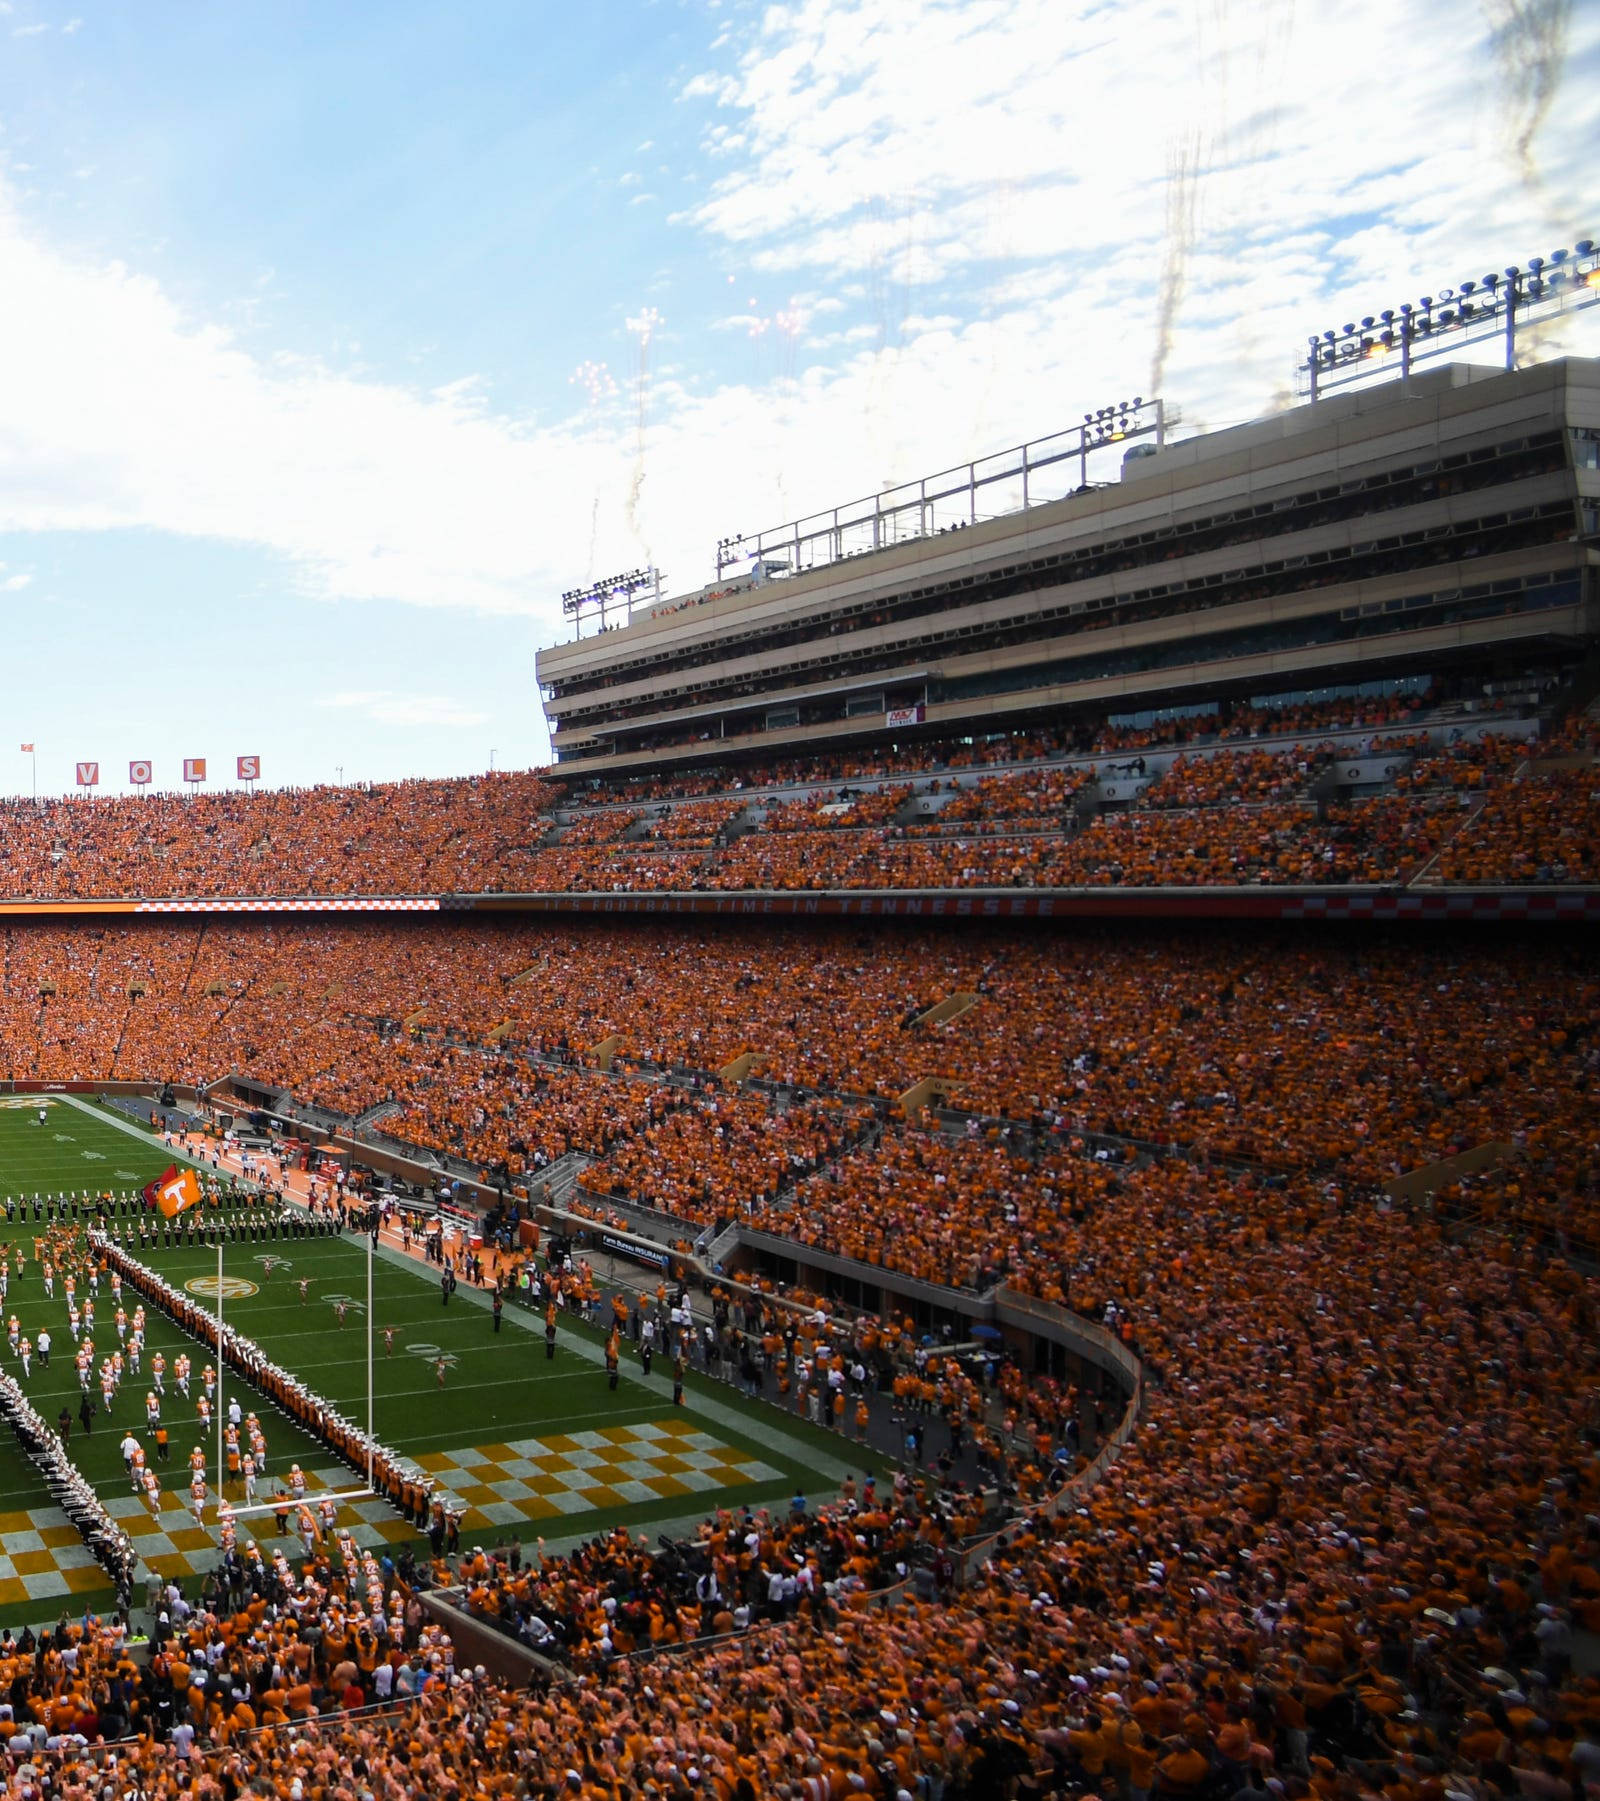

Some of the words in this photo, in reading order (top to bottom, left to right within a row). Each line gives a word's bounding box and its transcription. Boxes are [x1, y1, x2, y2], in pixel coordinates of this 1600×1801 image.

[544, 899, 580, 911] IT'S
[592, 899, 700, 912] FOOTBALL
[714, 899, 775, 912] TIME
[792, 900, 818, 913] IN
[839, 899, 1056, 915] TENNESSEE
[164, 1179, 186, 1210] T
